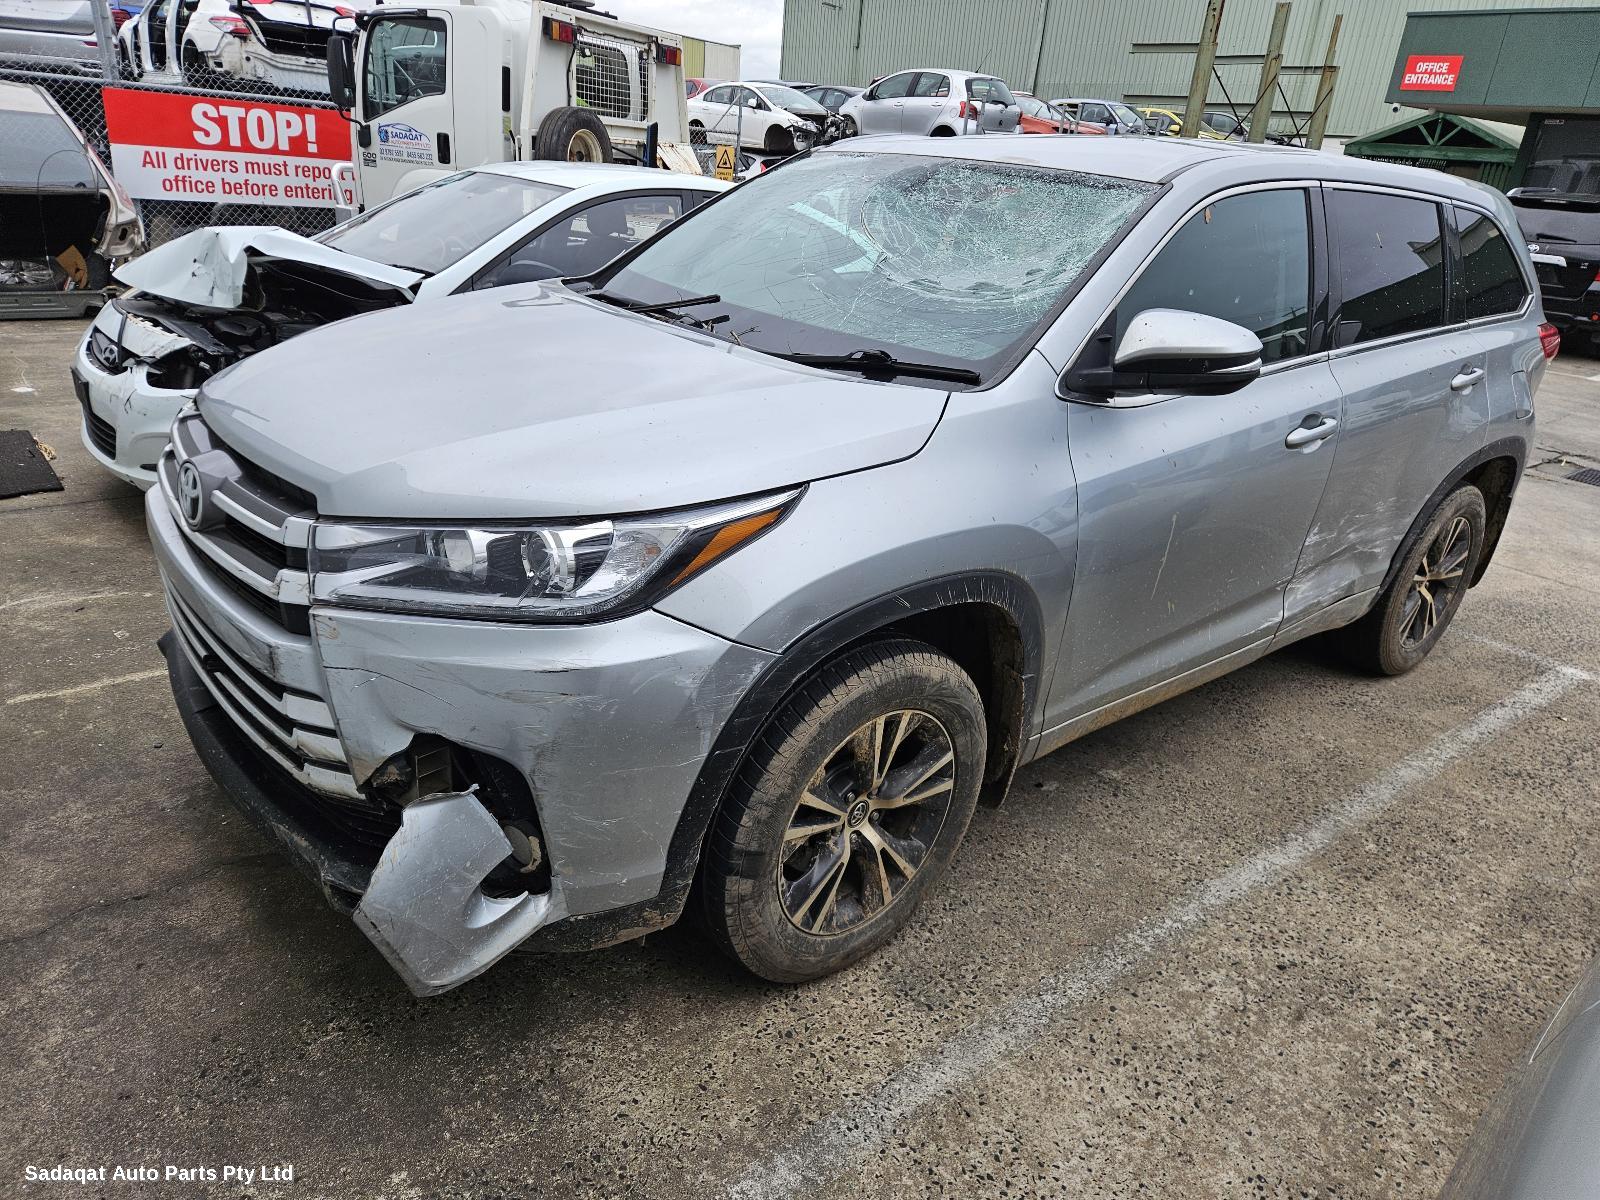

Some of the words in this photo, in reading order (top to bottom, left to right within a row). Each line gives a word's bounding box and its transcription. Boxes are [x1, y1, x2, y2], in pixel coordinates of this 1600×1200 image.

[1416, 62, 1450, 73] OFFICE
[1404, 73, 1455, 85] ENTRANCE
[191, 102, 319, 153] STOP!
[391, 131, 422, 141] SADAQAT
[142, 150, 167, 169] All
[174, 152, 239, 174] drivers
[245, 159, 289, 177] must
[295, 164, 346, 182] repo
[162, 175, 216, 194] office
[221, 177, 279, 198] before
[284, 183, 353, 204] enterig
